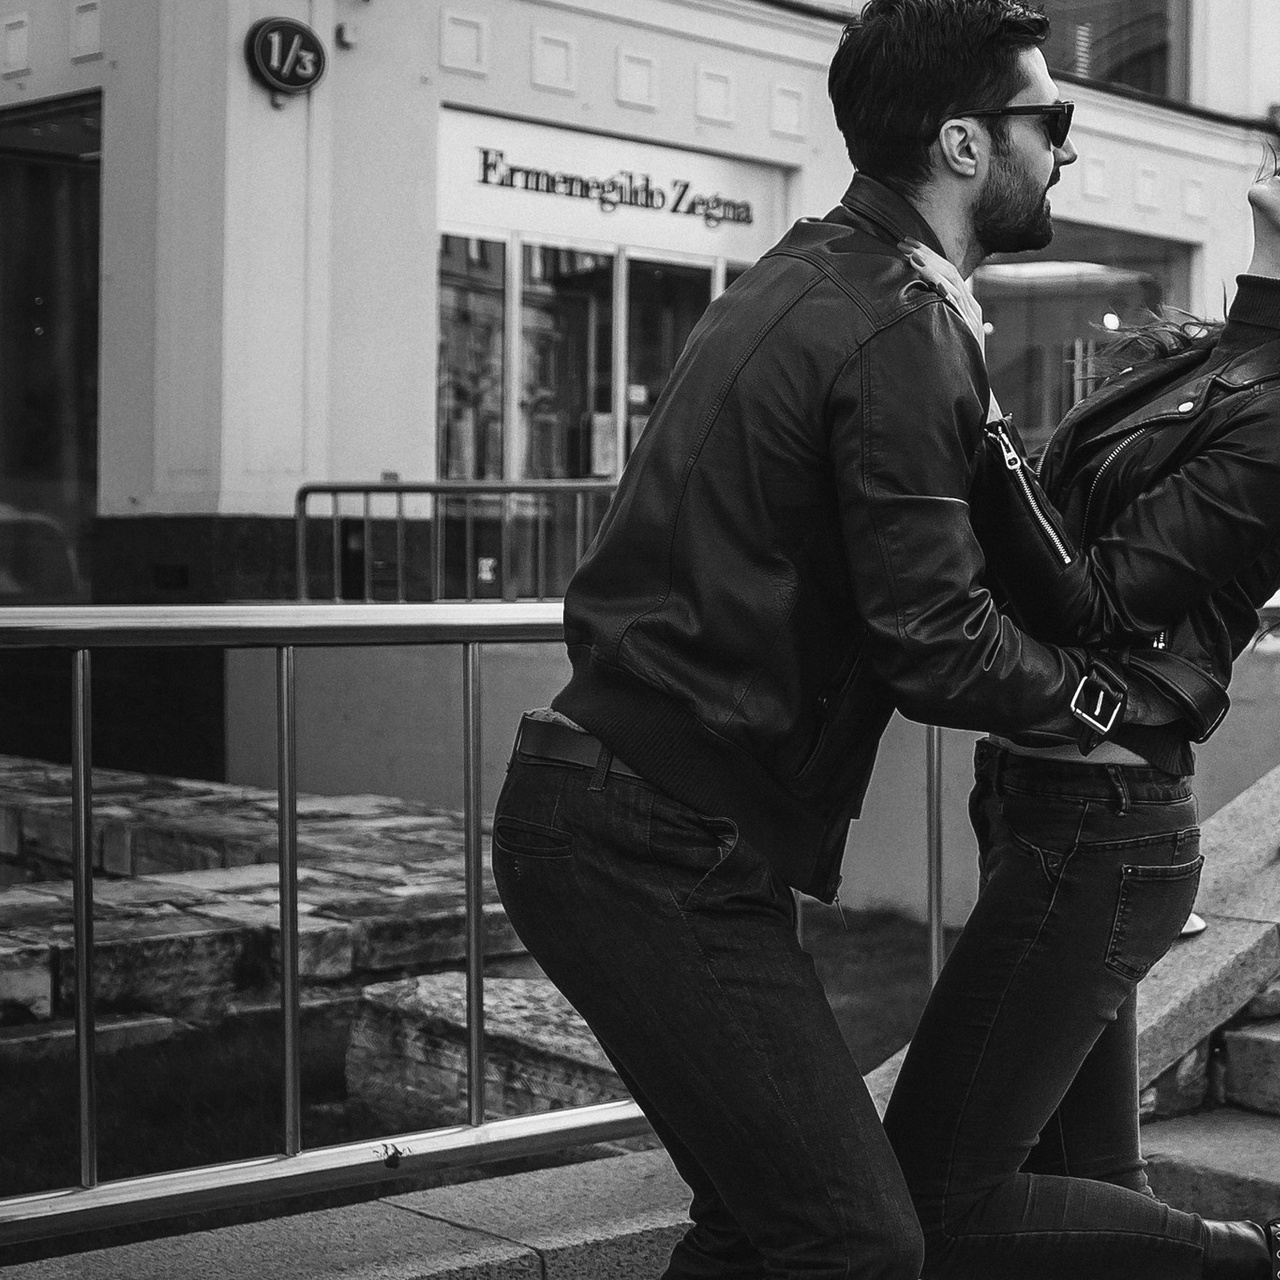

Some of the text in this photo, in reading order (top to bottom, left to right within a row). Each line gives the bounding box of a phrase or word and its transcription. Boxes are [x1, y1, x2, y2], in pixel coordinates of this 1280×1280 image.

[265, 30, 318, 79] 1/3
[475, 145, 755, 228] Ermenegildo Zegna
